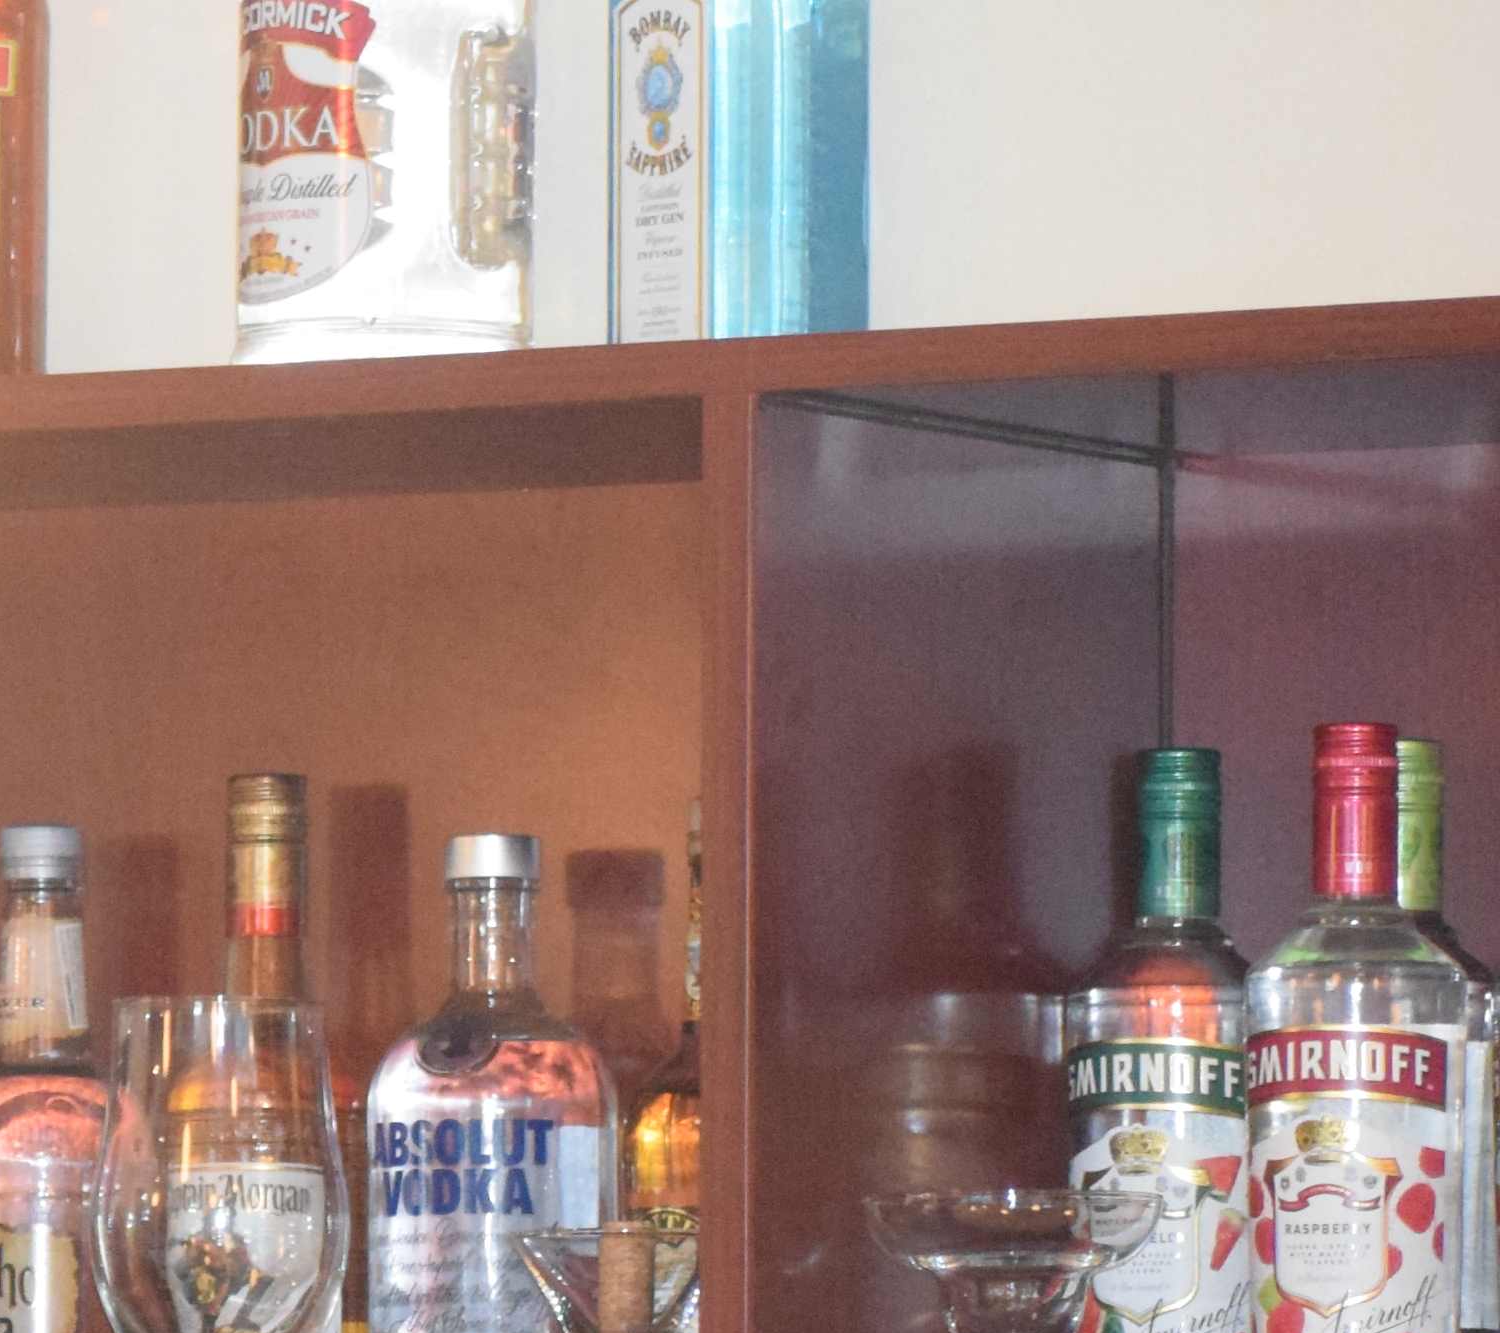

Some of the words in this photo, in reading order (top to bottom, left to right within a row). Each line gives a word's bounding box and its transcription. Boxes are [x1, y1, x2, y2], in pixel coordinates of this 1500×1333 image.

[629, 10, 690, 47] BOMBAY
[626, 142, 692, 176] SAPPHIRE
[267, 173, 358, 201] Distilled
[1069, 1052, 1242, 1101] SMIRNOFF
[1248, 1040, 1432, 1089] SMIRNOFF
[374, 1118, 554, 1168] ABSOLUT
[382, 1168, 534, 1217] VODKA
[1285, 1223, 1372, 1235] RASPBERY
